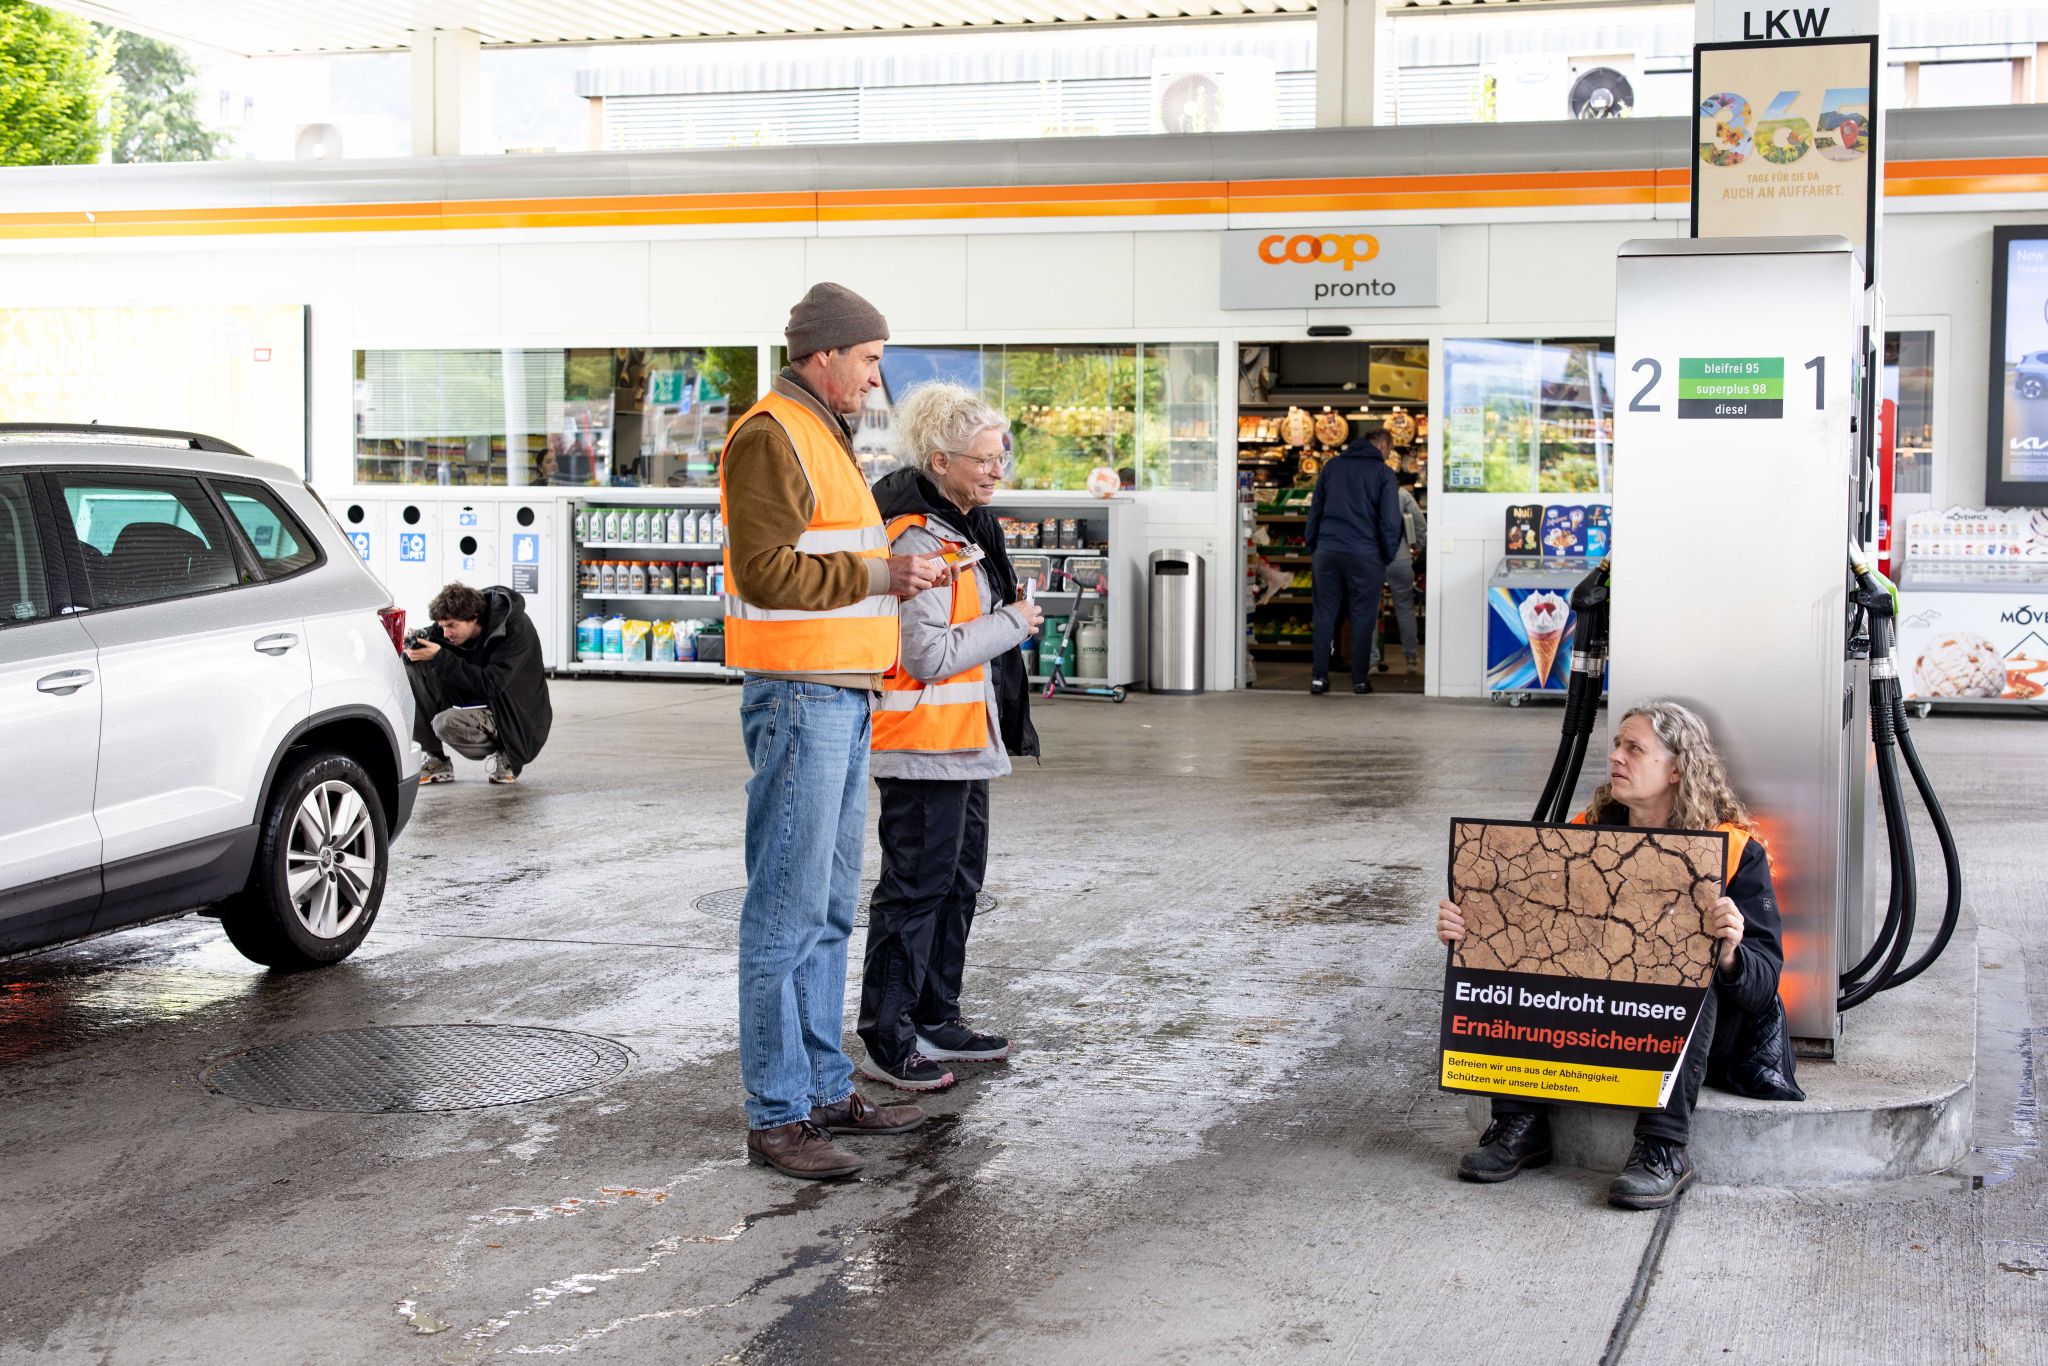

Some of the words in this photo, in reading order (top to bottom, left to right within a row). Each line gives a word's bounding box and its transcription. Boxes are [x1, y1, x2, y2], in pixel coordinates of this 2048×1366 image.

[1743, 7, 1830, 40] LKW
[1699, 87, 1869, 167] 365
[1747, 173, 1769, 183] TAGE
[1771, 171, 1790, 182] FÜR
[1791, 172, 1805, 182] SIE
[1807, 172, 1820, 181] DA
[1722, 187, 1754, 200] AUCH
[1758, 186, 1775, 199] AN
[1778, 184, 1845, 198] AUFFAHRT.
[1258, 233, 1380, 271] coop
[2016, 249, 2046, 261] New
[1314, 278, 1396, 301] pronto
[1704, 362, 1743, 374] bleifrei
[1745, 362, 1760, 374] 95
[1628, 357, 1662, 413] 2
[1696, 383, 1750, 396] superplus
[1752, 383, 1768, 395] 98
[1804, 355, 1826, 411] 1
[1714, 403, 1747, 415] diesel
[1455, 981, 1513, 1006] Erdöl
[1518, 987, 1605, 1014] bedroht
[1610, 1000, 1687, 1021] unsere
[1451, 1014, 1685, 1054] Ernährungssicherheit
[1446, 1071, 1491, 1084] Schützen
[1492, 1075, 1506, 1086] wir
[1507, 1078, 1539, 1089] unsere
[1540, 1080, 1581, 1093] Liebsten.
[1448, 1057, 1488, 1070] Befreien
[1489, 1062, 1504, 1071] wir
[1505, 1064, 1522, 1073] uns
[1523, 1066, 1541, 1075] aus
[1542, 1065, 1558, 1076] der
[1559, 1068, 1621, 1084] Abhängigkeit.
